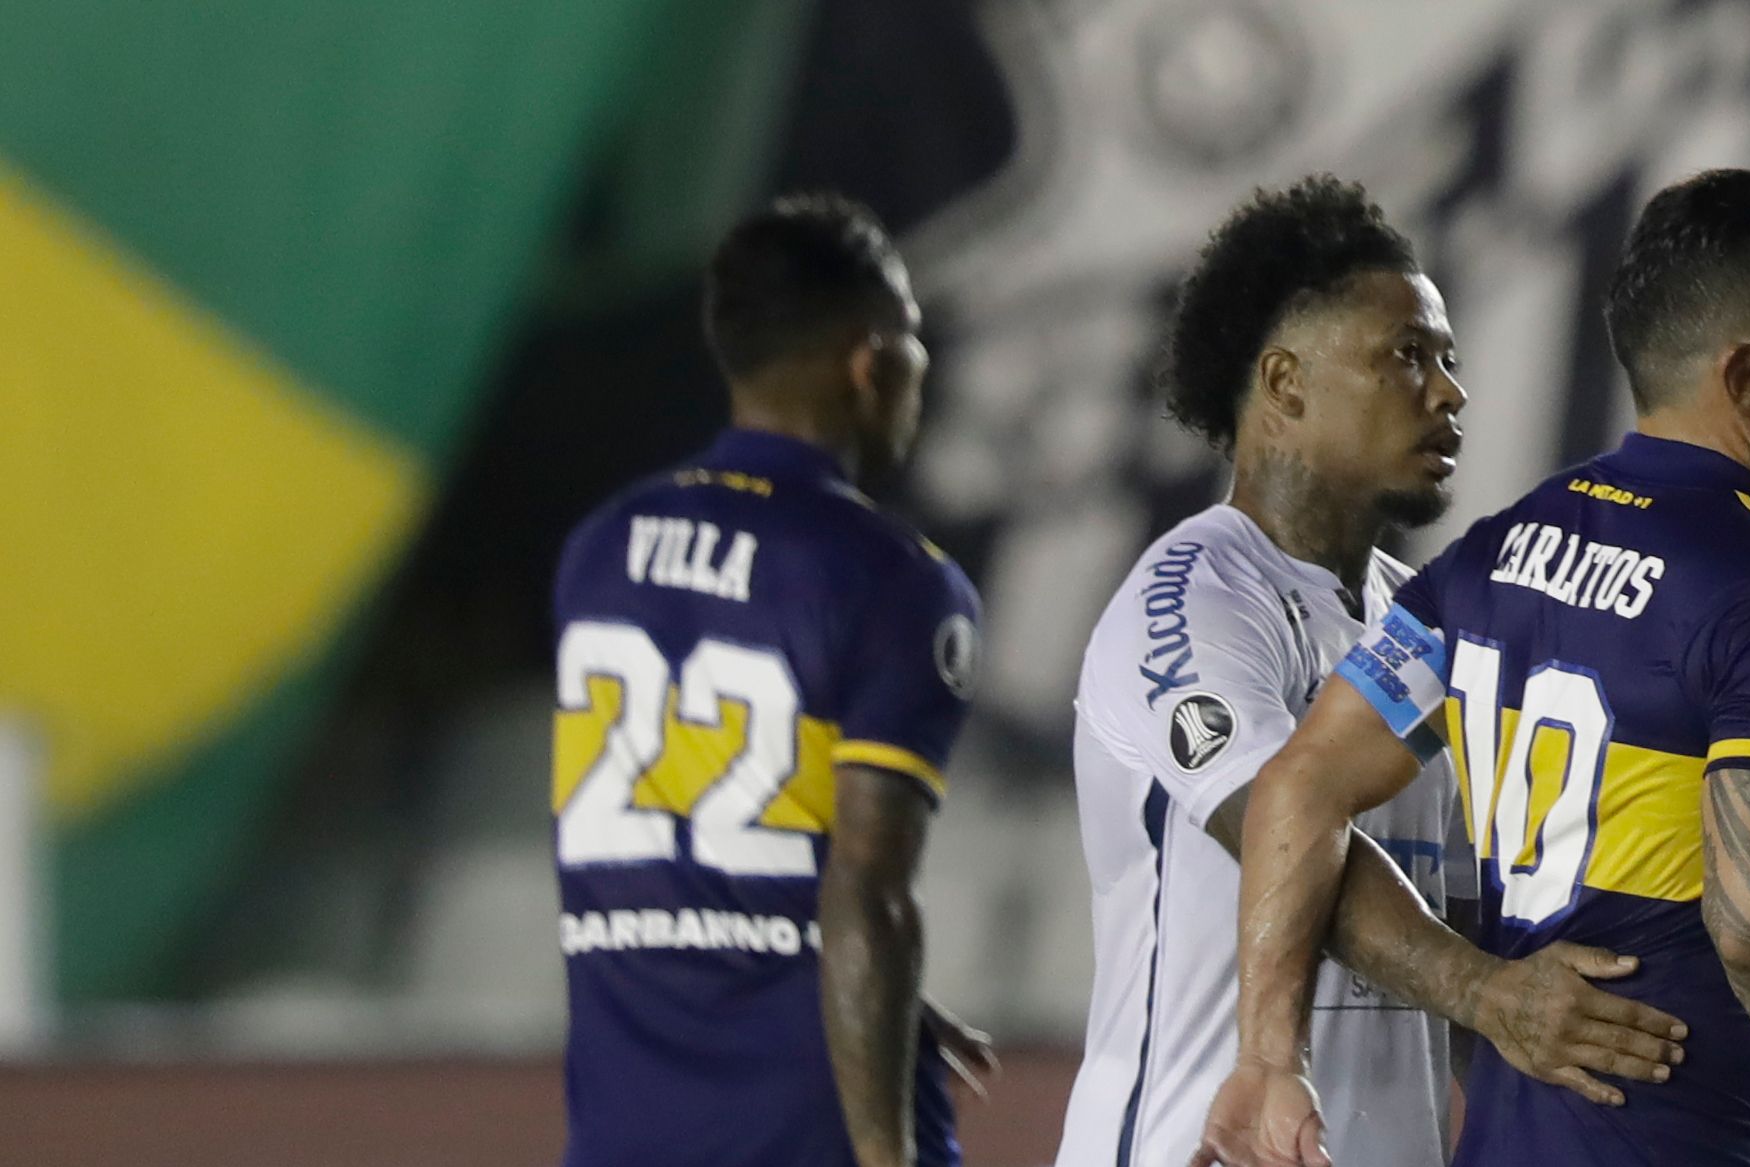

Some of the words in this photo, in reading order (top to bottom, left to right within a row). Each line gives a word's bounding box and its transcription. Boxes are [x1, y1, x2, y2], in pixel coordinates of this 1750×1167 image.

[626, 515, 759, 602] VILLA
[556, 619, 818, 878] 22
[1446, 628, 1616, 934] 10
